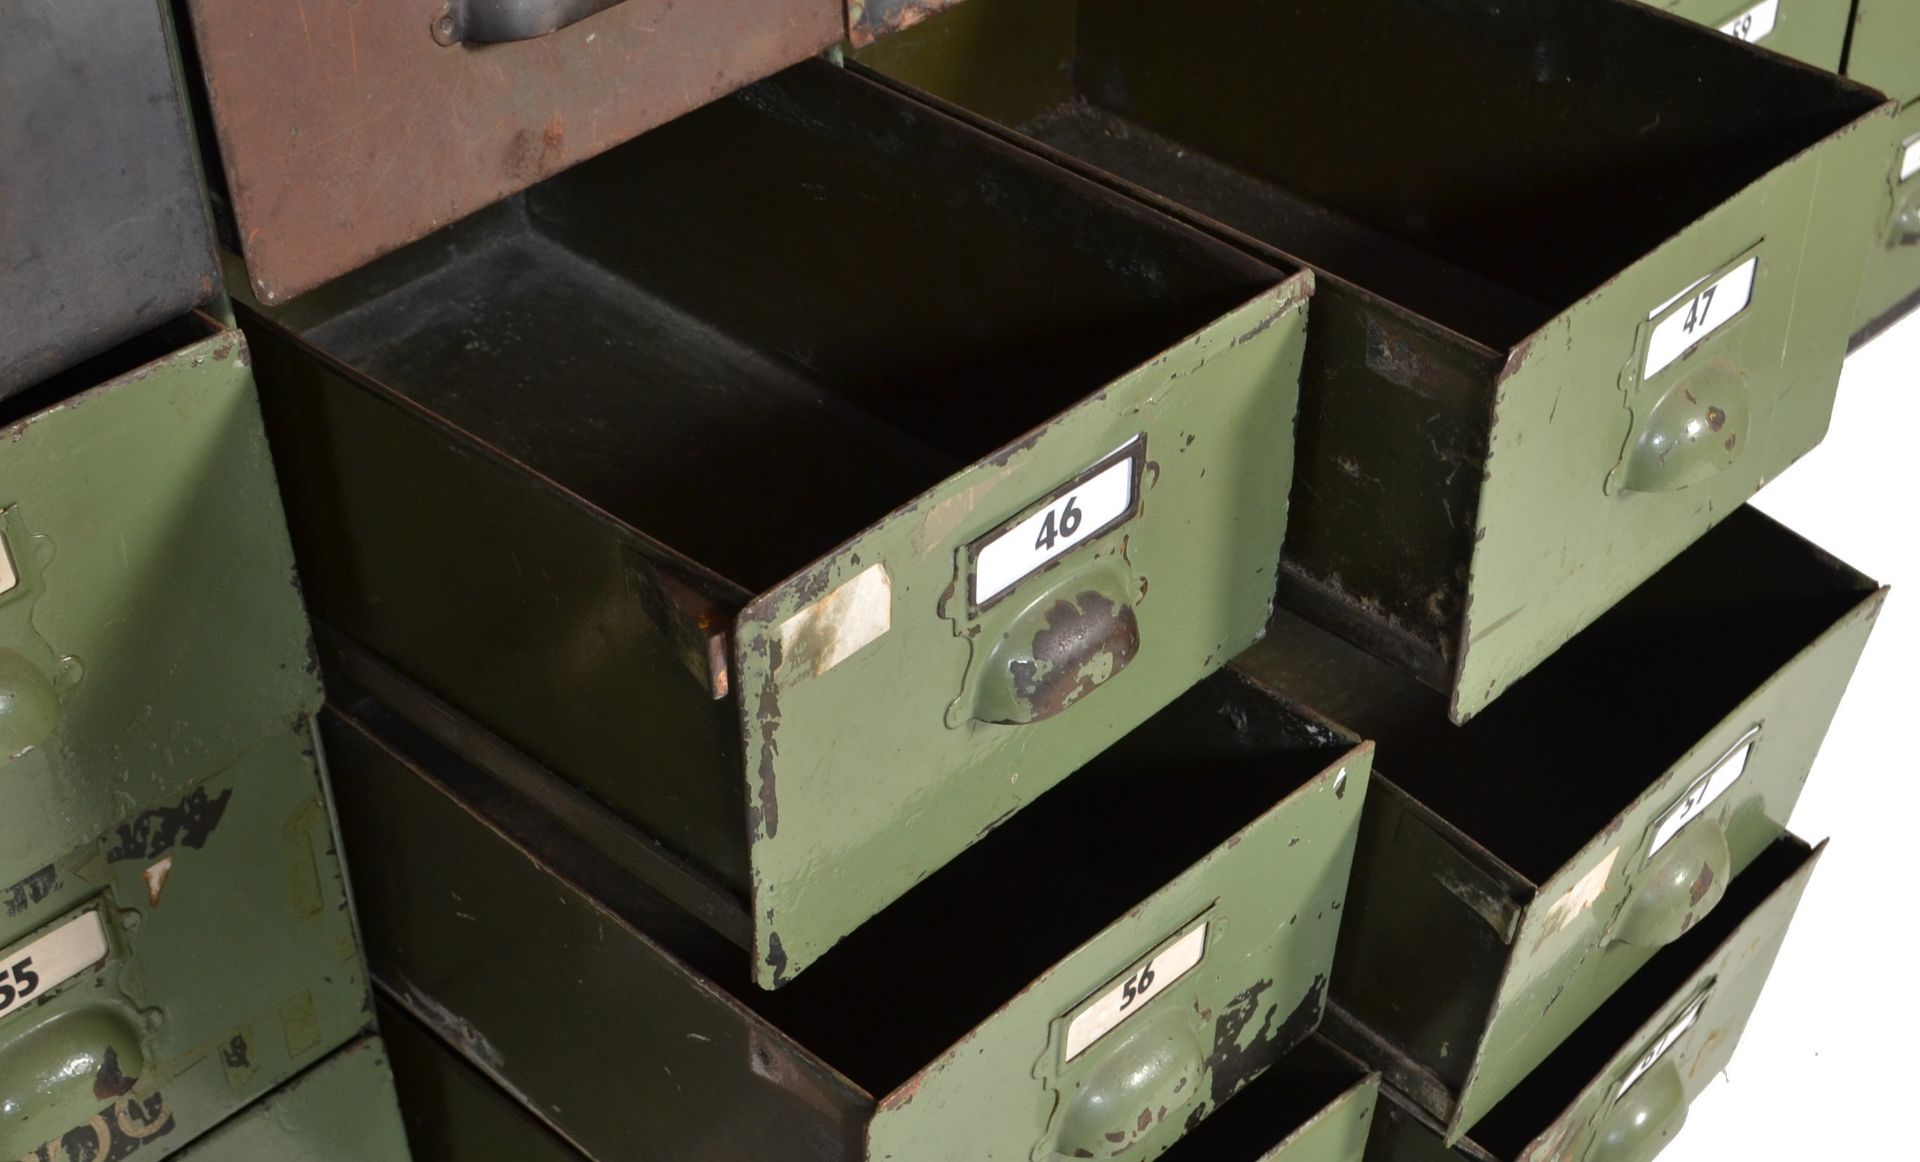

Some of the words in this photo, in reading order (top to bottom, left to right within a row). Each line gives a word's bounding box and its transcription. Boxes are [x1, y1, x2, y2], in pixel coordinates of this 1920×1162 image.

[1683, 283, 1718, 334] 47
[1035, 495, 1082, 551] 46
[1119, 959, 1155, 1011] 56
